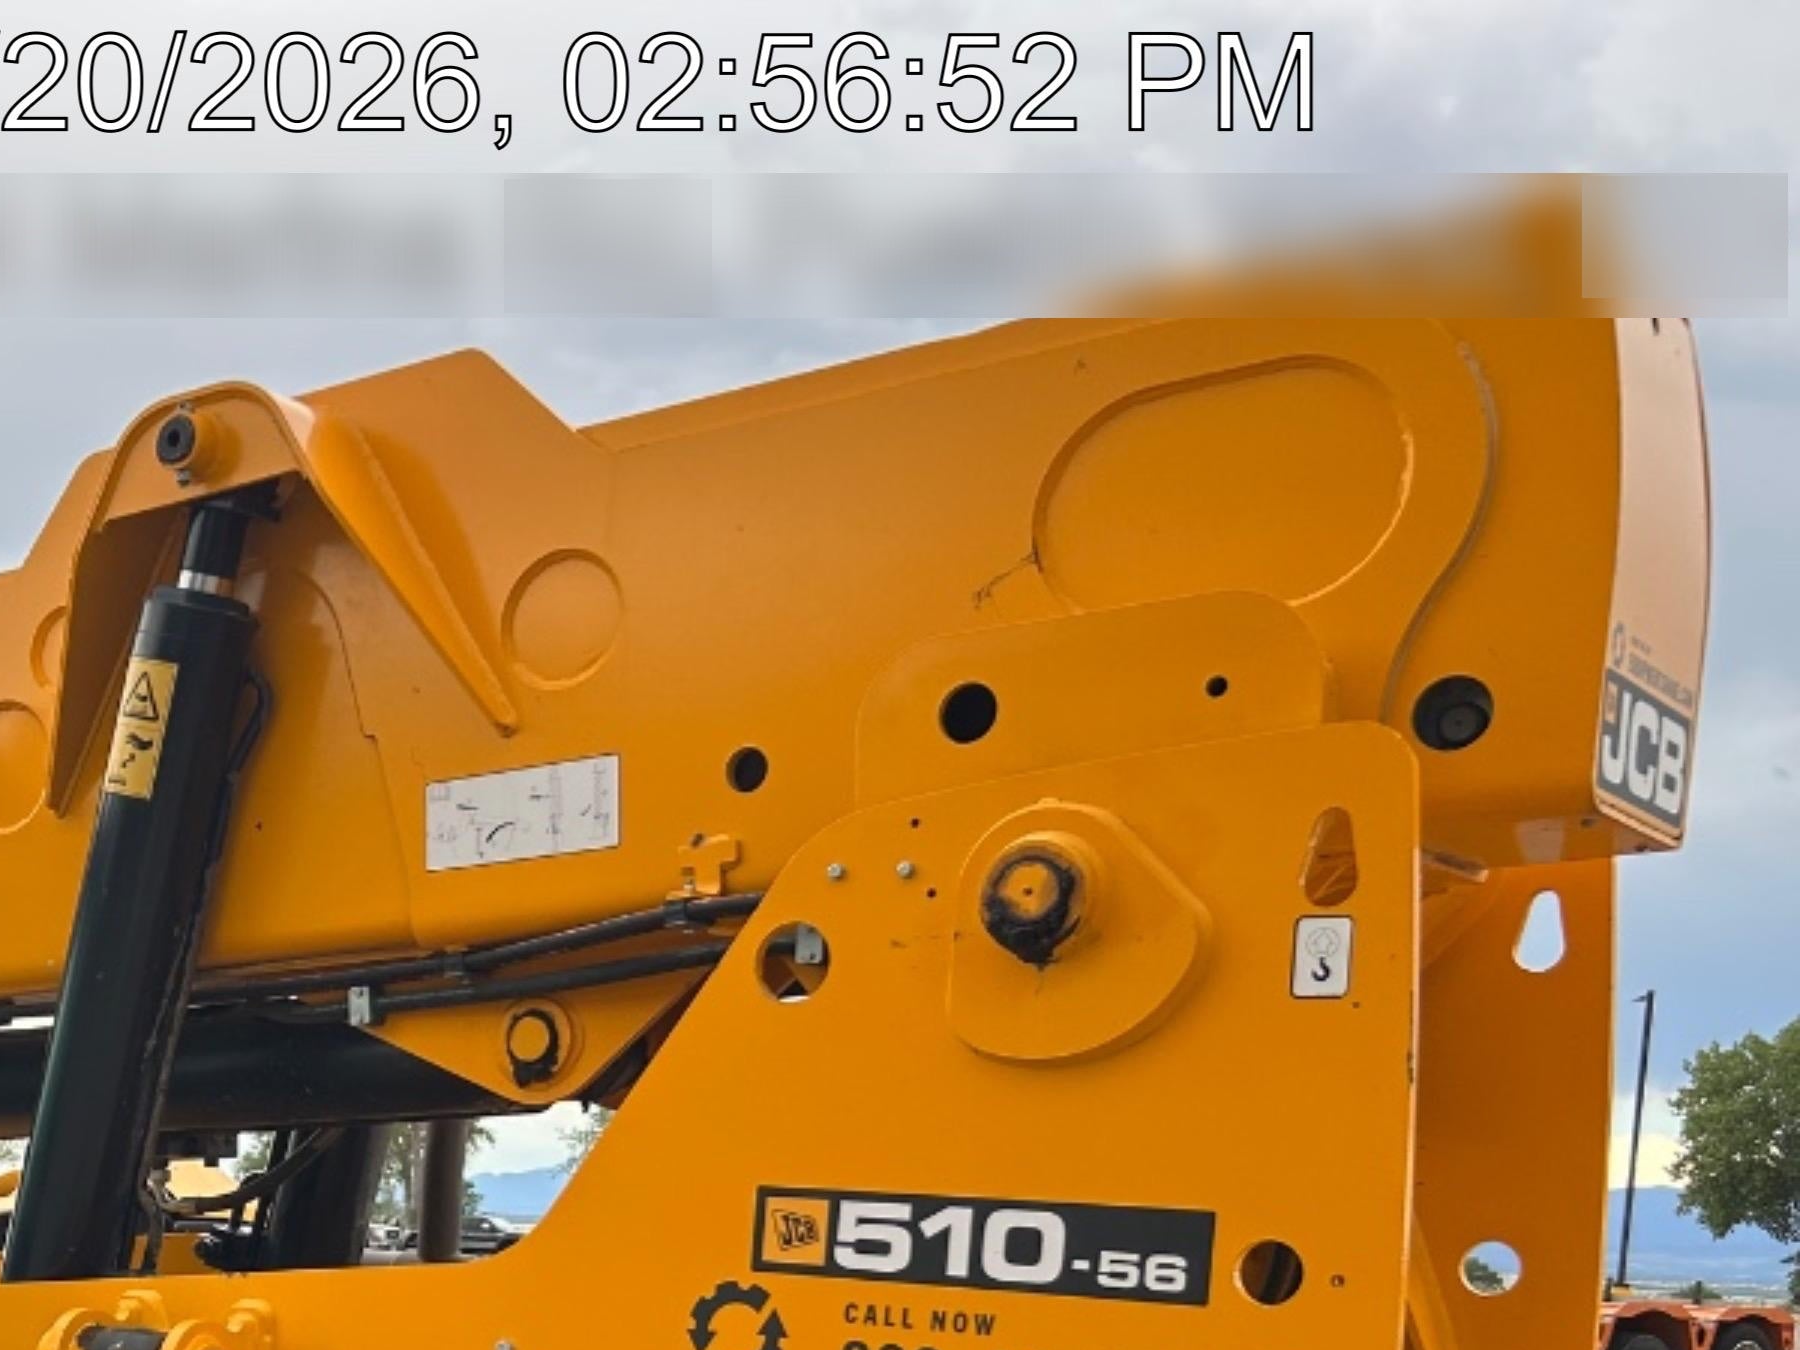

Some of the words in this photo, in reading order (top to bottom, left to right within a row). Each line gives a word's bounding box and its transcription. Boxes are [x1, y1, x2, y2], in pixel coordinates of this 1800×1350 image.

[1602, 690, 1686, 813] JCB
[833, 1199, 1188, 1294] 510-56
[843, 1303, 913, 1330] CALL
[930, 1310, 997, 1337] NOW
